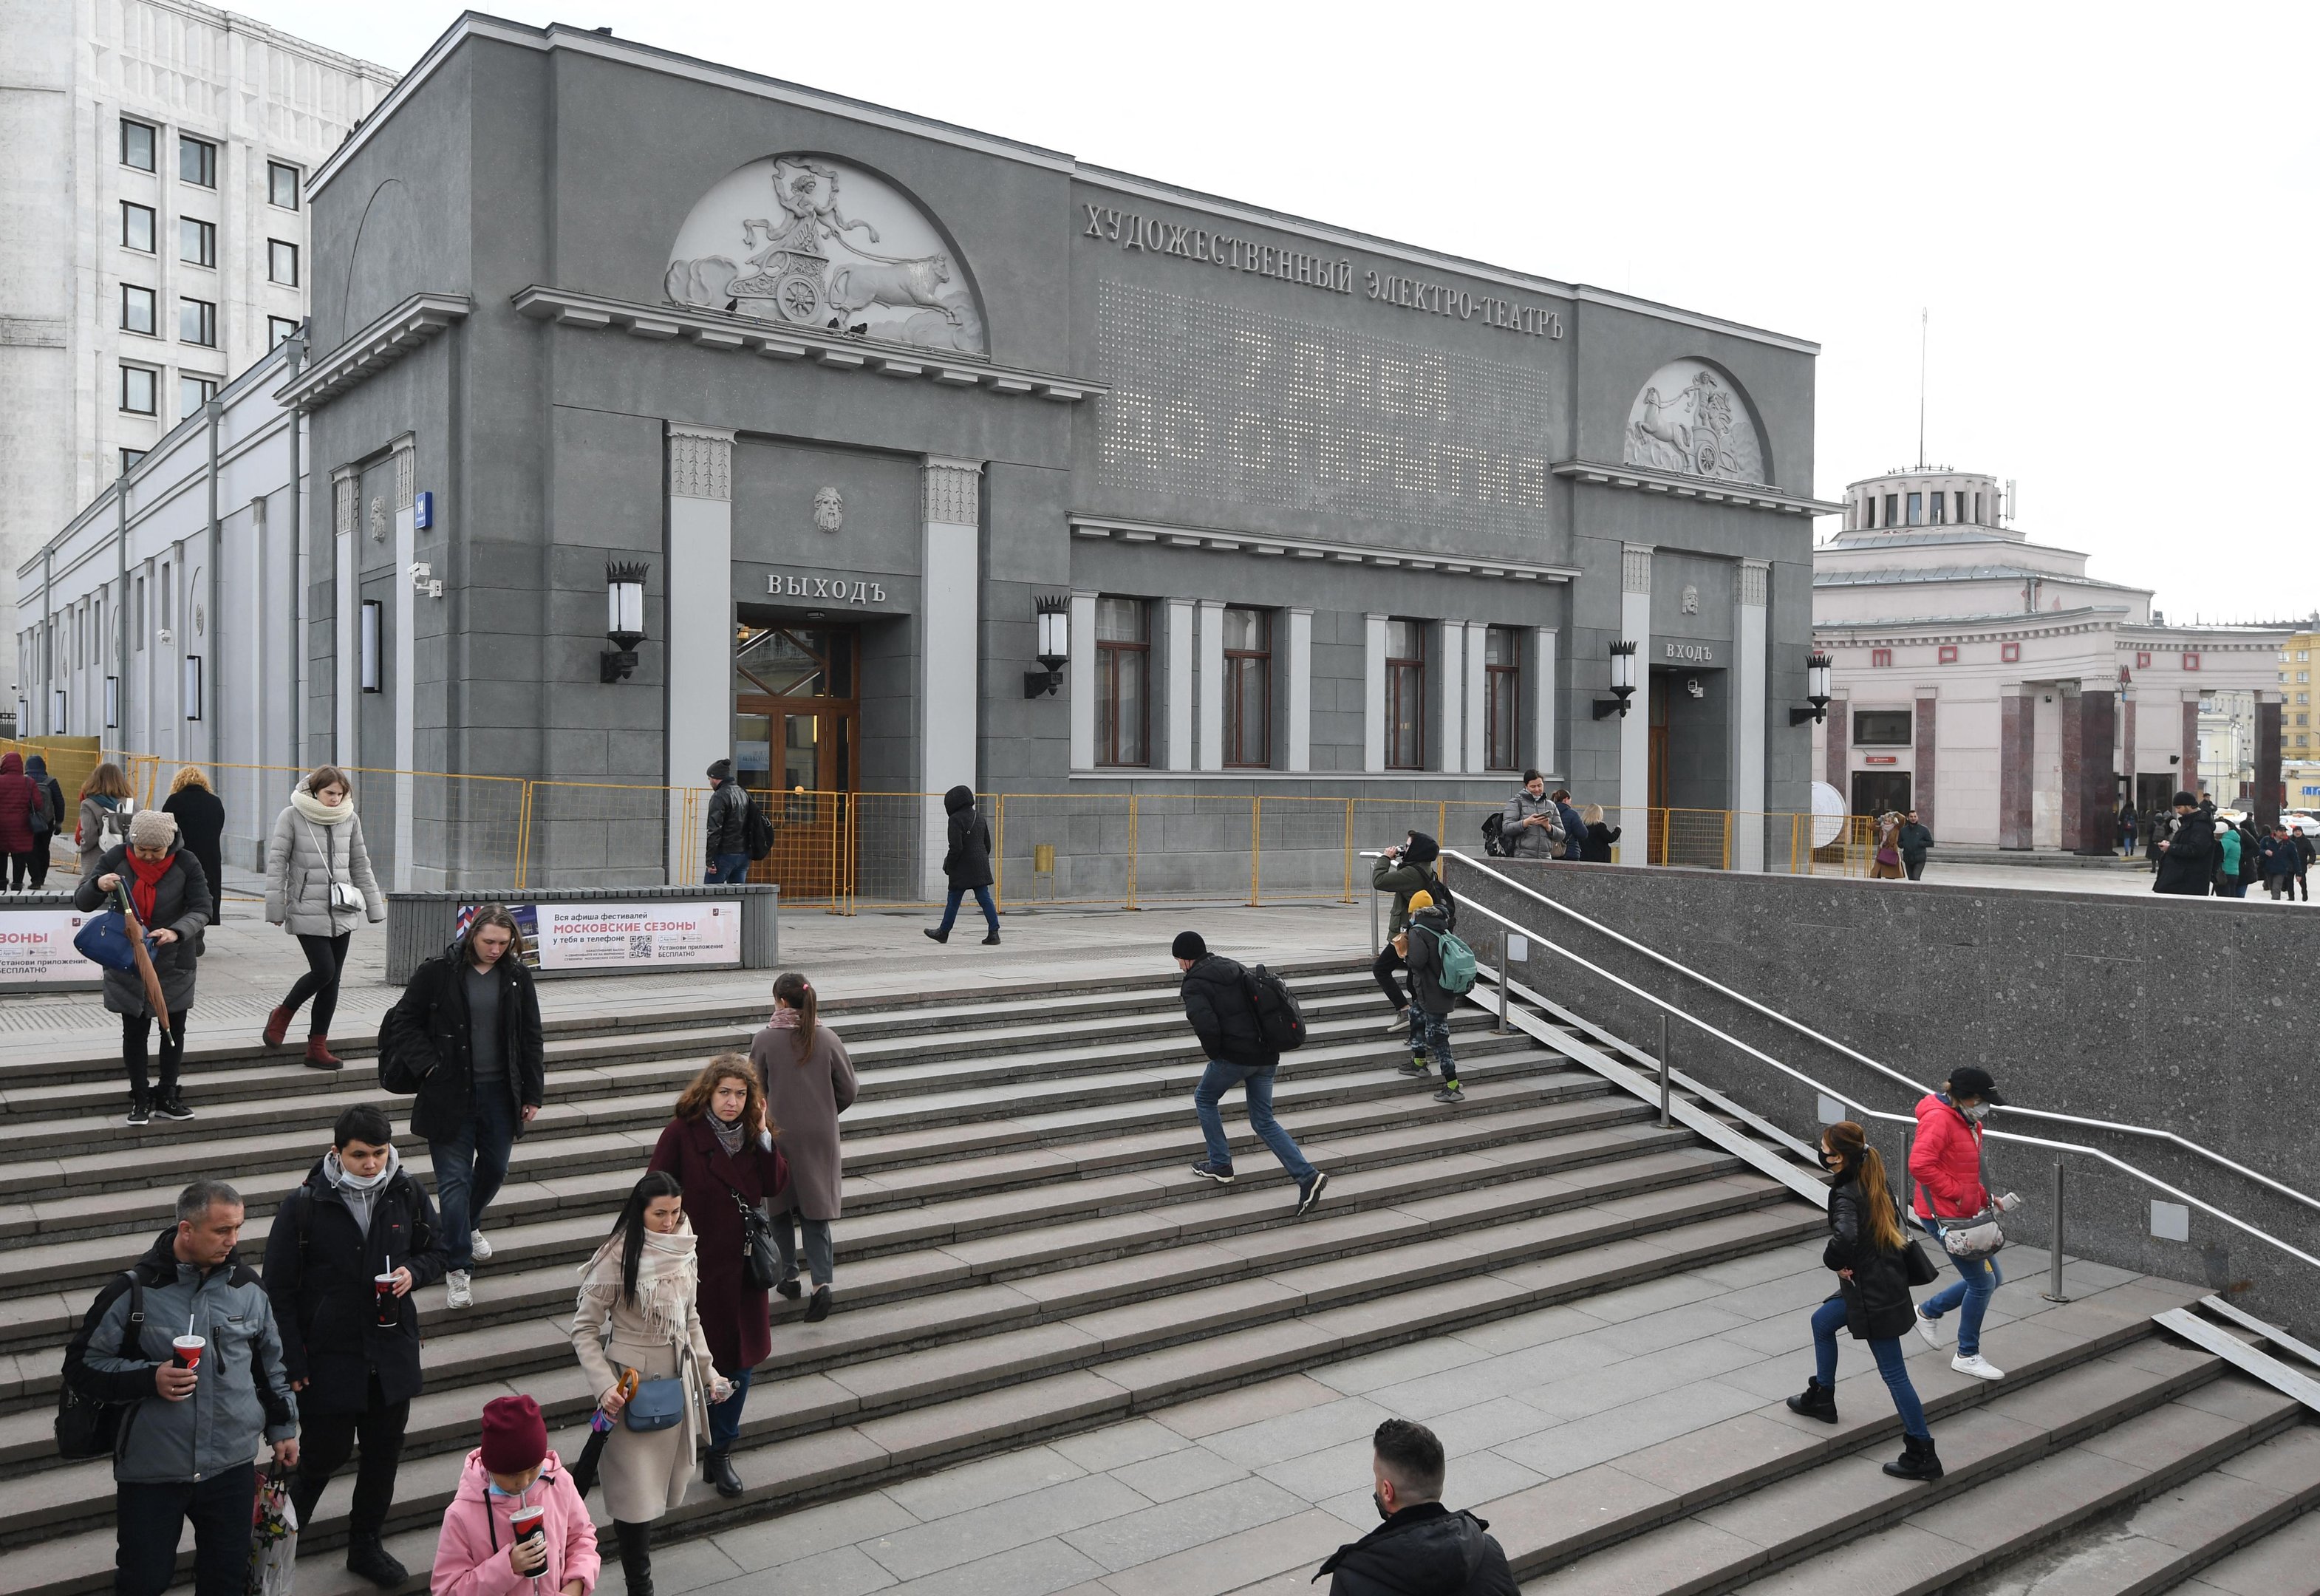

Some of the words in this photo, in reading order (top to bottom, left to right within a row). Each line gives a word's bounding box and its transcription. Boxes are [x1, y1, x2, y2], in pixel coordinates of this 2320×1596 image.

[1083, 203, 1353, 293] ХУДОЖЕСТВЕННЫЙ
[1365, 270, 1563, 340] ЭЛЕКТРО-ТЕАТРЪ
[1235, 330, 1272, 386] 7
[1289, 341, 1446, 420] ДНЕЙ
[1104, 390, 1204, 468] ДО
[1228, 411, 1543, 508] ОТКРЫТИЯ
[417, 499, 423, 514] 14
[767, 574, 886, 604] ВЫХОДЪ
[1665, 644, 1712, 662] ВХОДЪ
[571, 913, 598, 922] афиша
[601, 912, 647, 921] фестивалей
[553, 923, 641, 934] МОСКОВСКИЕ
[644, 921, 696, 932] СЕЗОНЫ
[587, 935, 625, 944] телефоне
